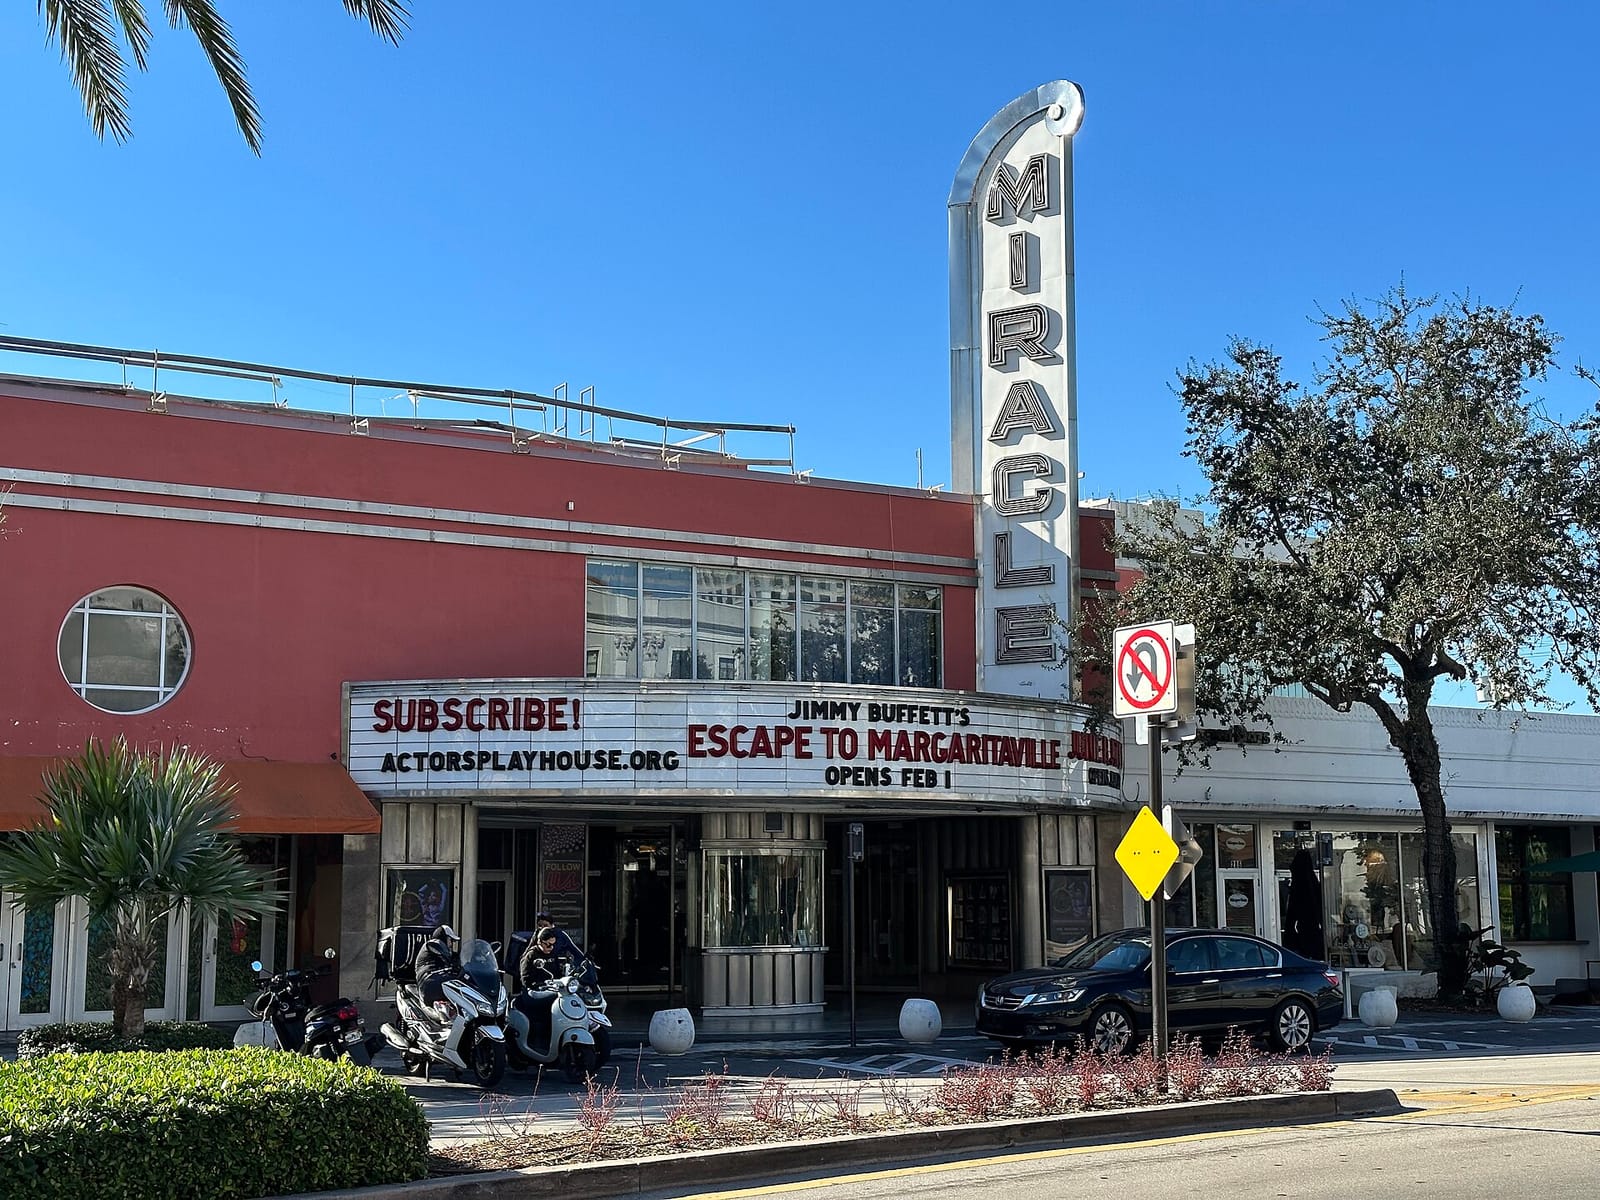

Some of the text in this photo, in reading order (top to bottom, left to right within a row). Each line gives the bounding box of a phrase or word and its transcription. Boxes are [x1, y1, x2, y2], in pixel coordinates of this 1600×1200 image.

[986, 152, 1057, 665] MIRACLE
[372, 697, 581, 732] SUBSCRIBE!
[787, 699, 970, 726] JIMMY BUFFETT'S
[687, 724, 813, 759] ESCAPE
[820, 727, 857, 760] TO
[867, 729, 1061, 769] MARGARITAVILLE
[380, 750, 680, 773] ACTORSPLAYHOUSE.ORG
[824, 765, 892, 787] OPENS
[901, 767, 939, 789] FEB
[545, 863, 581, 871] FOLLOW
